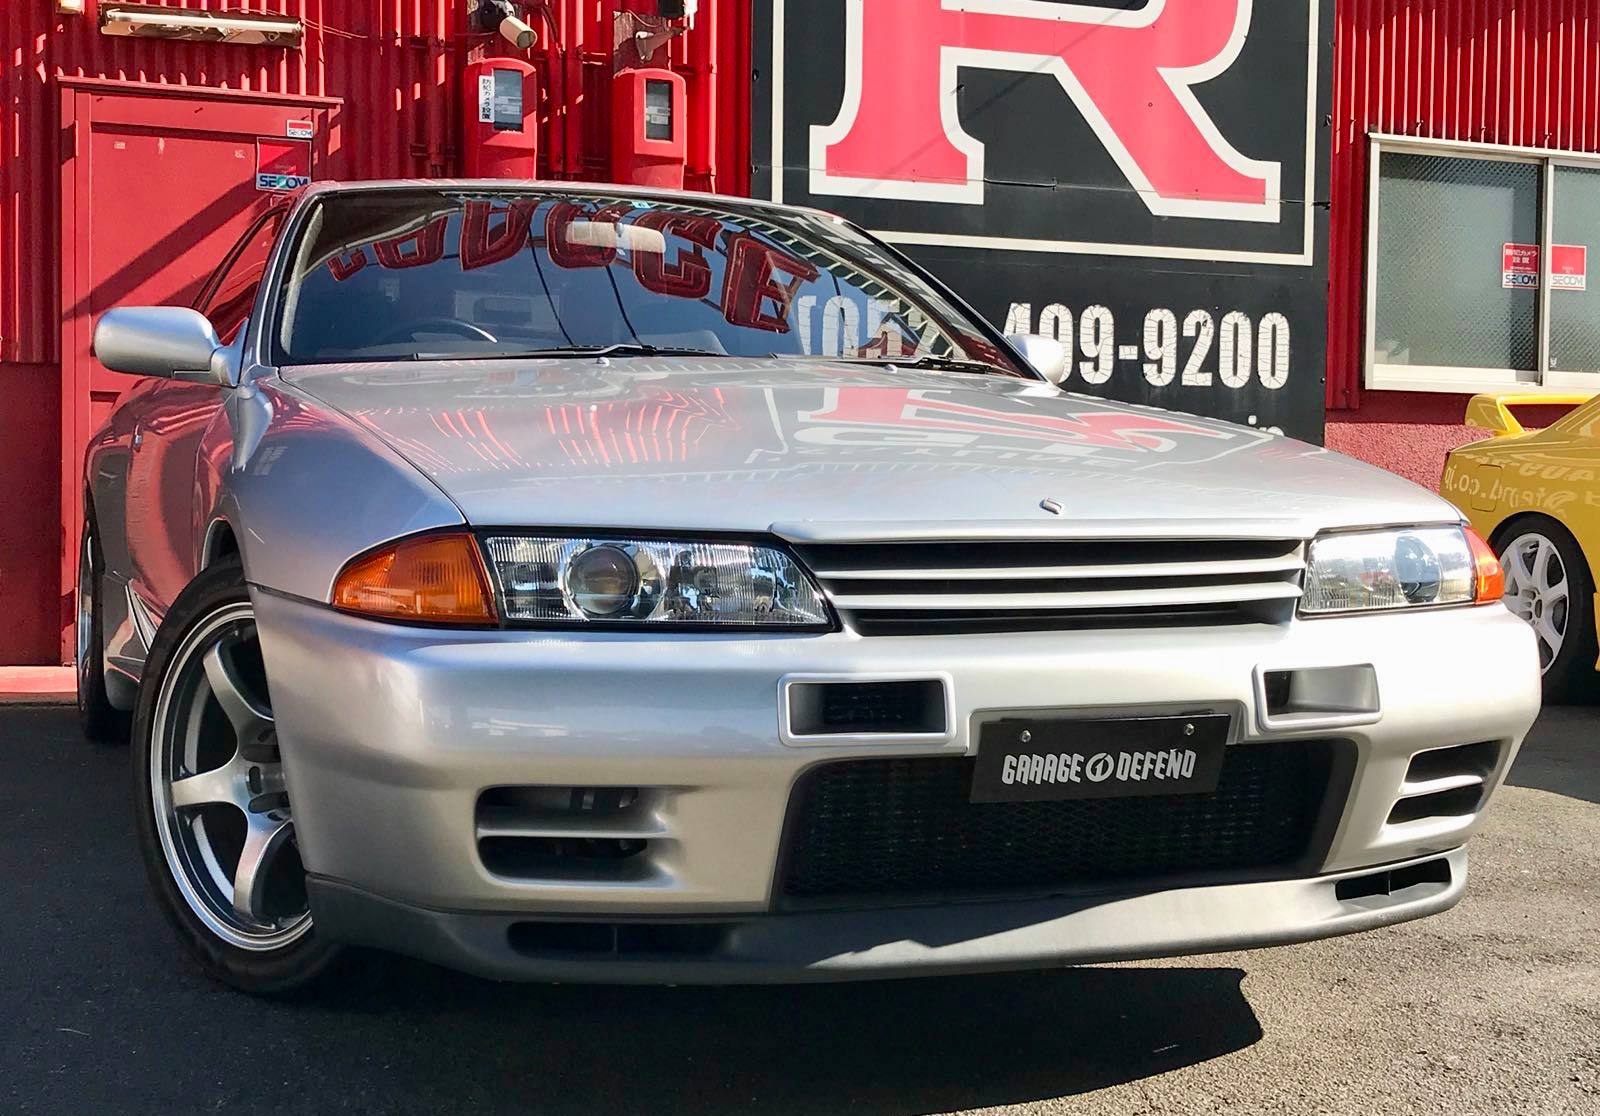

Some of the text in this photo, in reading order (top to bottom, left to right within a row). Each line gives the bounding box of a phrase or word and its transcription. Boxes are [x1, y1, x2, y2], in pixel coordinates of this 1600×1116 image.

[260, 175, 308, 188] SECOM
[1505, 274, 1537, 285] SECOM
[1552, 275, 1584, 286] SECOM
[1002, 750, 1197, 785] GARAGE DEFEND
